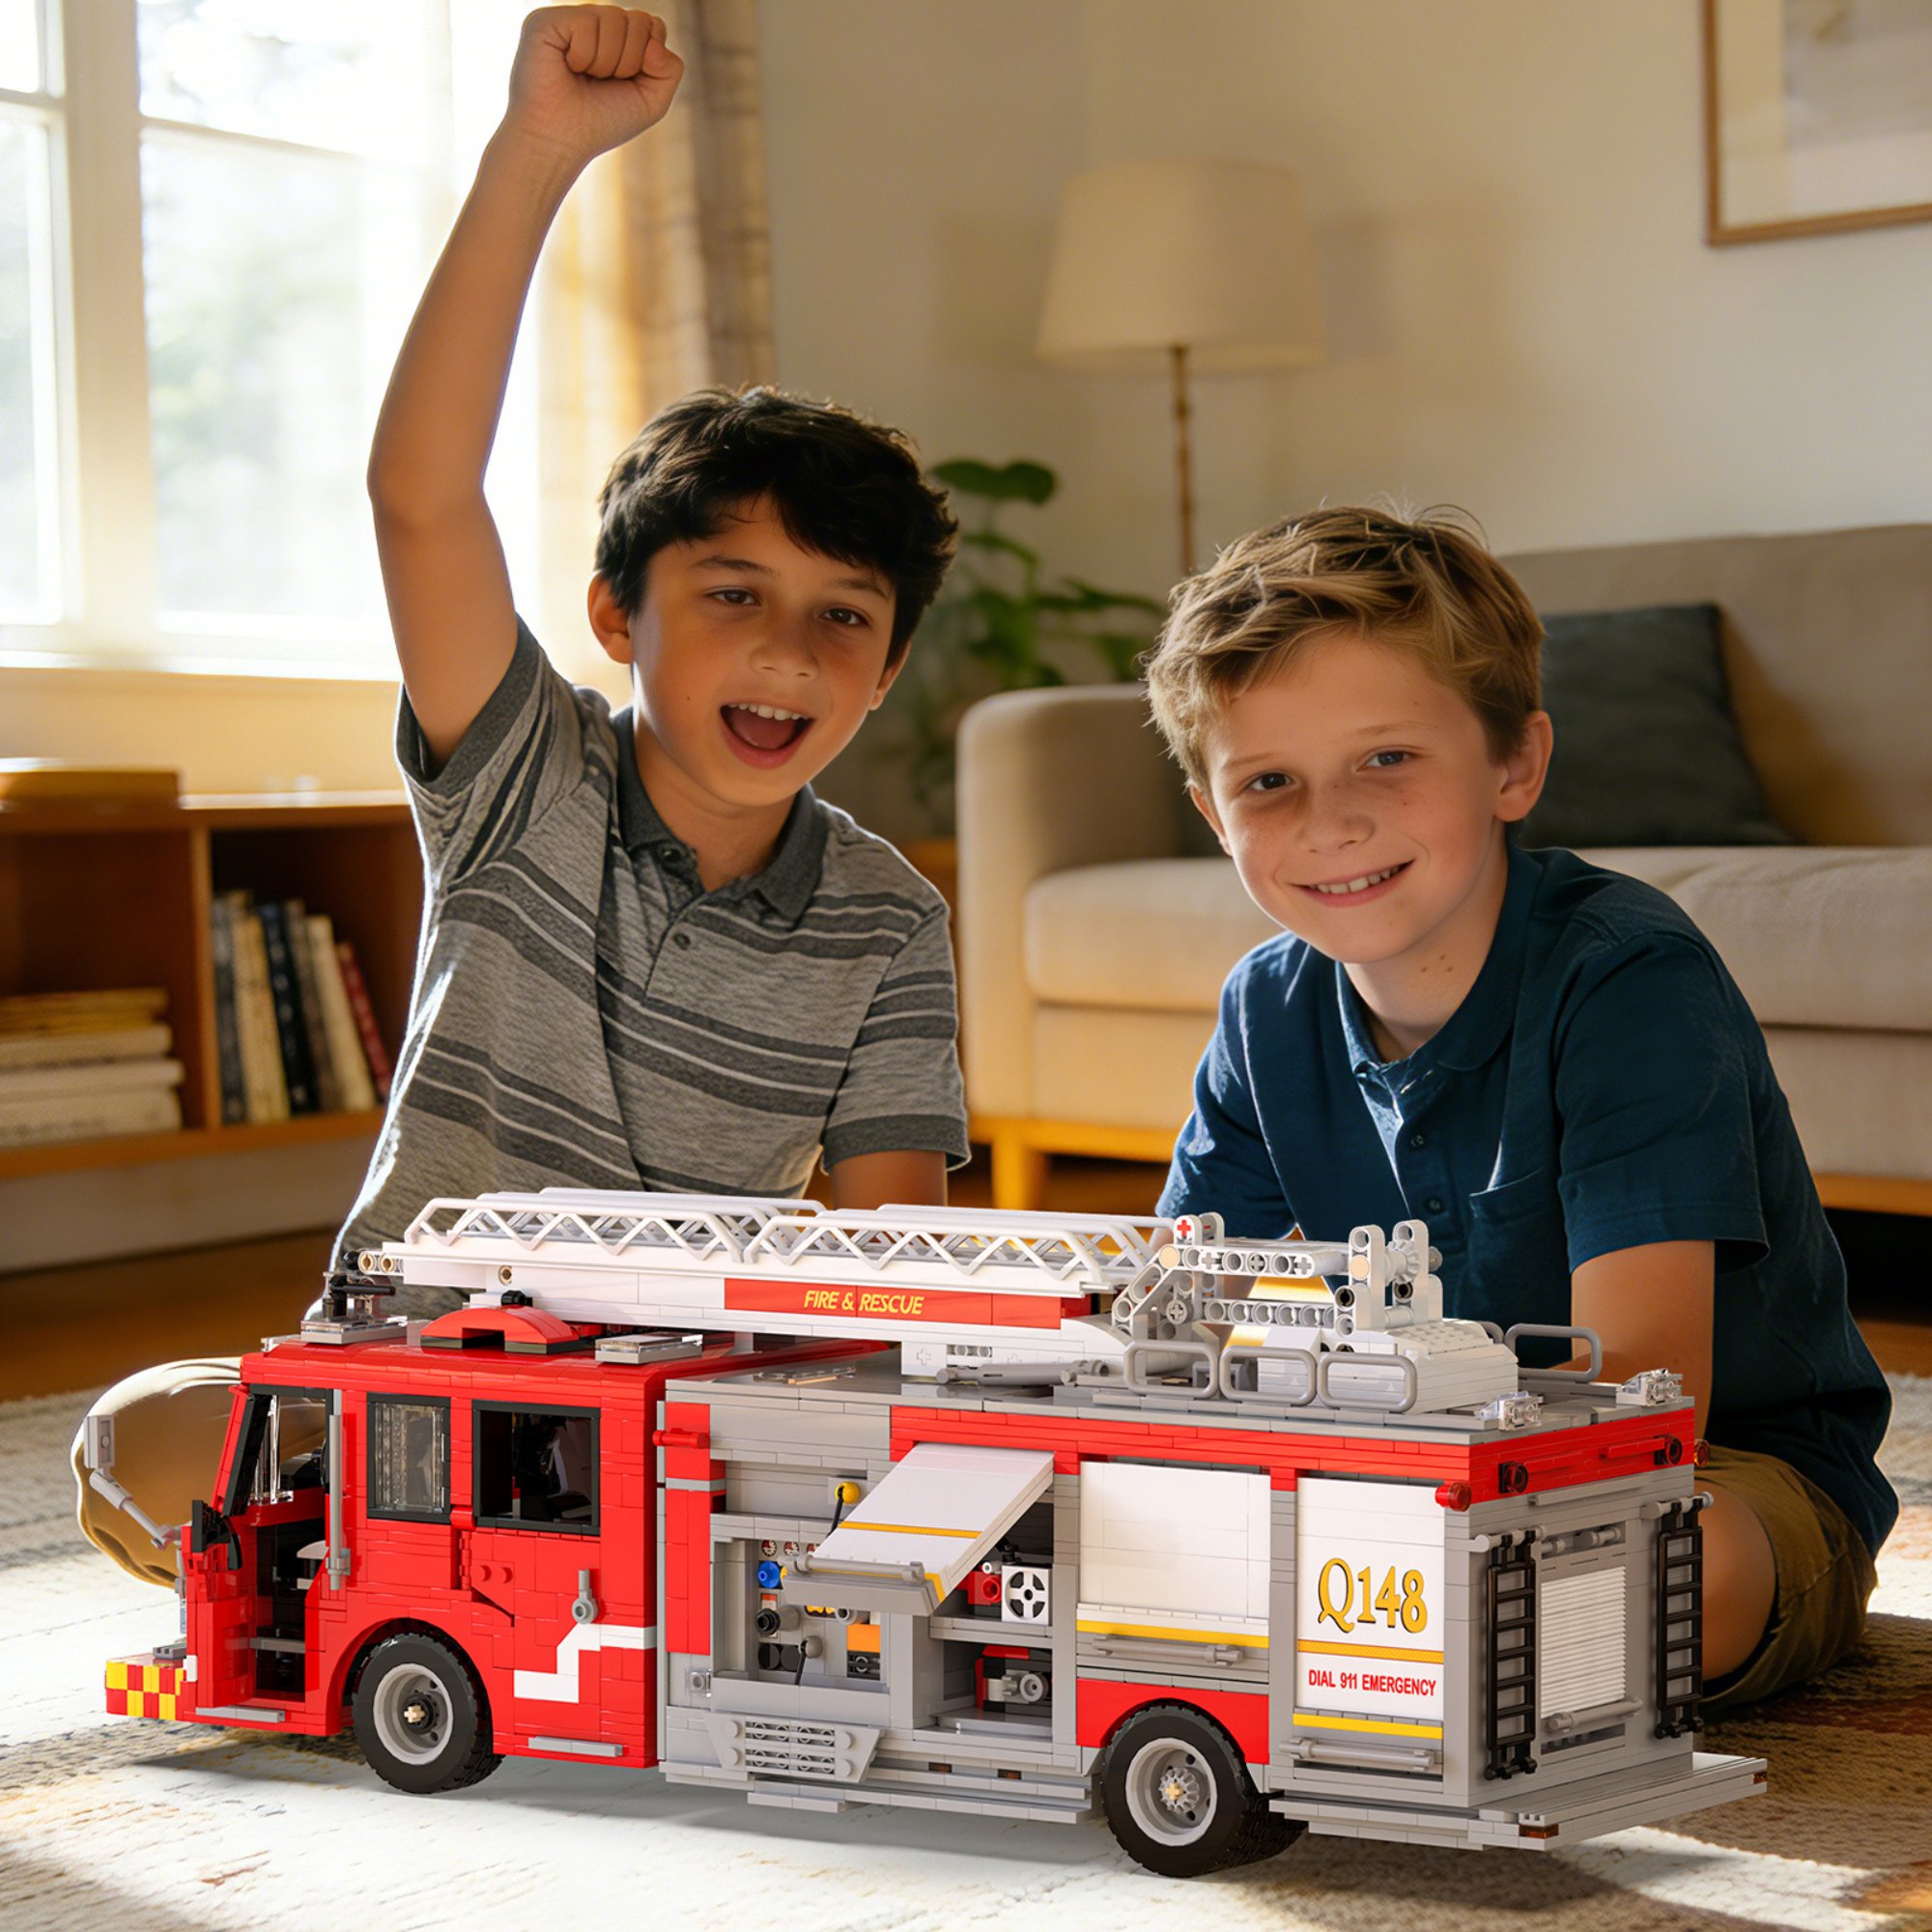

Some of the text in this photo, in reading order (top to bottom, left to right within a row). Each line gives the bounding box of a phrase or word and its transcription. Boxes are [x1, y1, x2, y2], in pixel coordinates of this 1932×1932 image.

[804, 1290, 925, 1315] FIRE & RESCUE
[1318, 1557, 1428, 1634] Q148
[1308, 1668, 1436, 1696] DIAL 911 EMERGENCY
